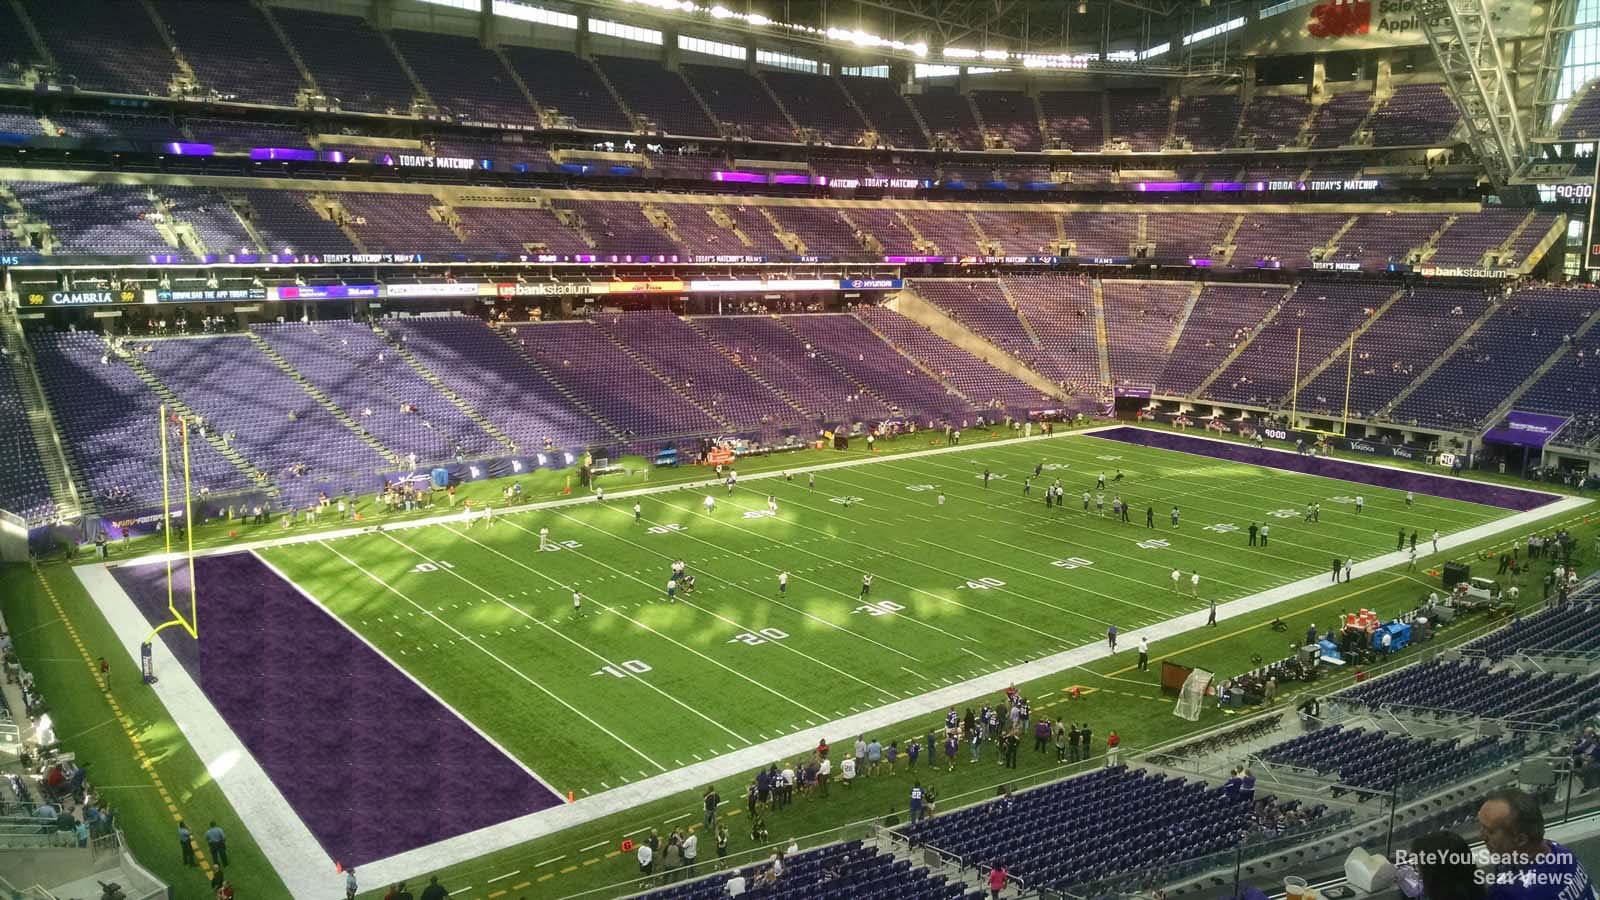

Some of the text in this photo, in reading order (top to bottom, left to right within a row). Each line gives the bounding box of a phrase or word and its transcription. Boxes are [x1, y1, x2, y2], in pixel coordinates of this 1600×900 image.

[400, 155, 475, 169] TODAY'S MATCHUP
[864, 178, 889, 188] TODAY'S
[890, 179, 919, 189] MATCHUP
[1311, 181, 1342, 191] TODAY'S
[1343, 180, 1378, 190] MATCHUP
[1557, 185, 1592, 198] 90:00
[1312, 262, 1335, 270] TODAY'S
[52, 293, 113, 304] CAMBRIA
[1265, 429, 1287, 440] 90:00
[966, 577, 1006, 589] 40
[855, 600, 906, 616] 30
[735, 627, 790, 645] 20
[601, 659, 654, 678] 10
